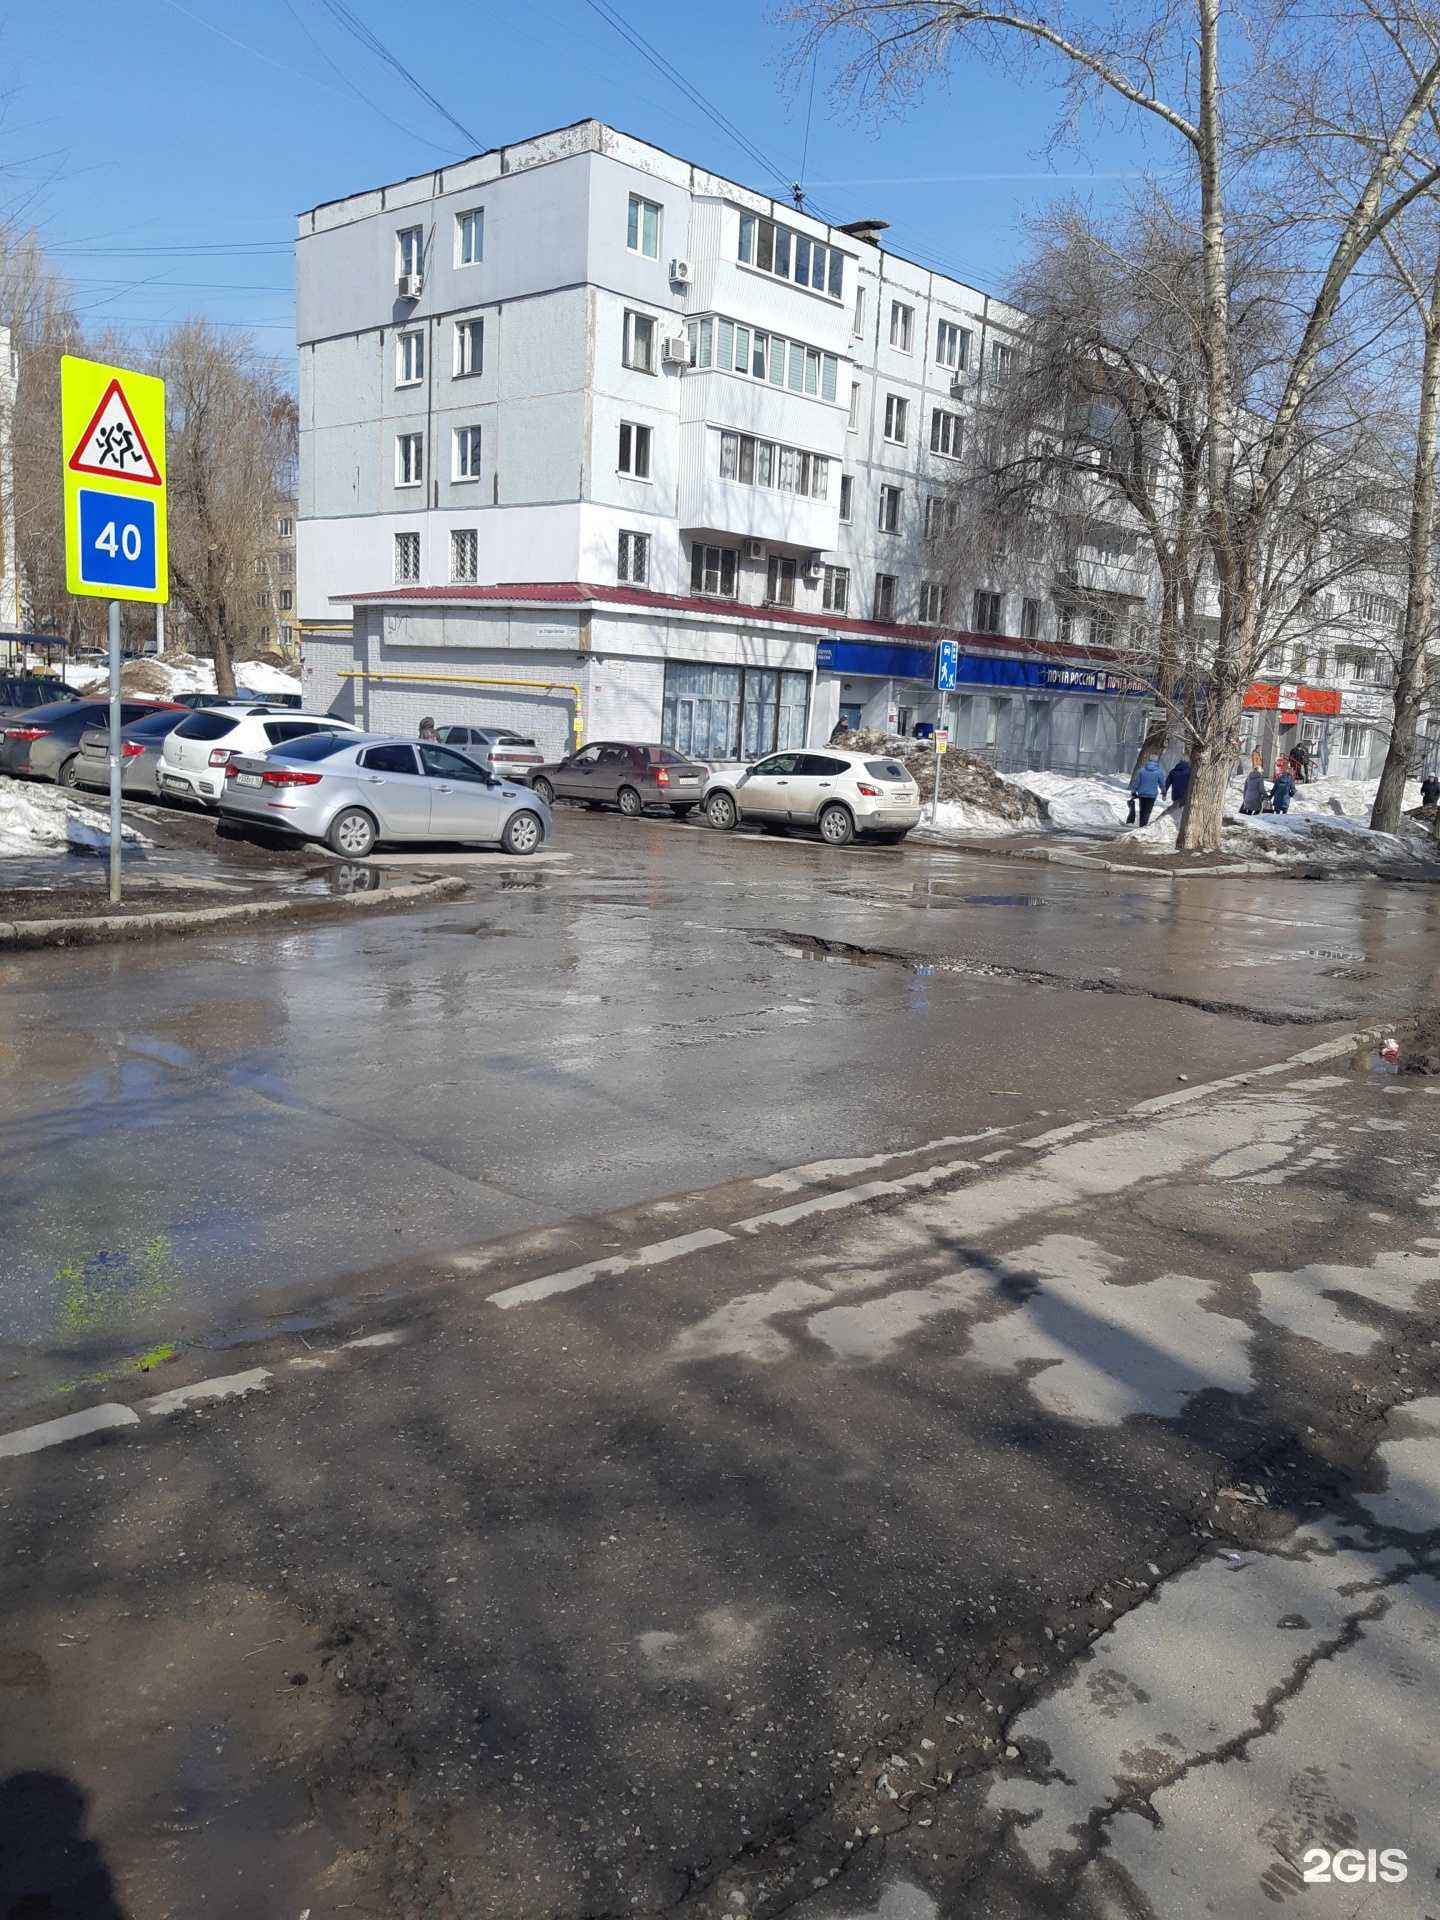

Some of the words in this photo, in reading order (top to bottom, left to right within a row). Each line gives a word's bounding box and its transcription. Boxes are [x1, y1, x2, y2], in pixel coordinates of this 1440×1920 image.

[95, 521, 142, 561] 40
[1048, 670, 1069, 684] ПОЧТА
[1070, 672, 1095, 687] РОССИИ
